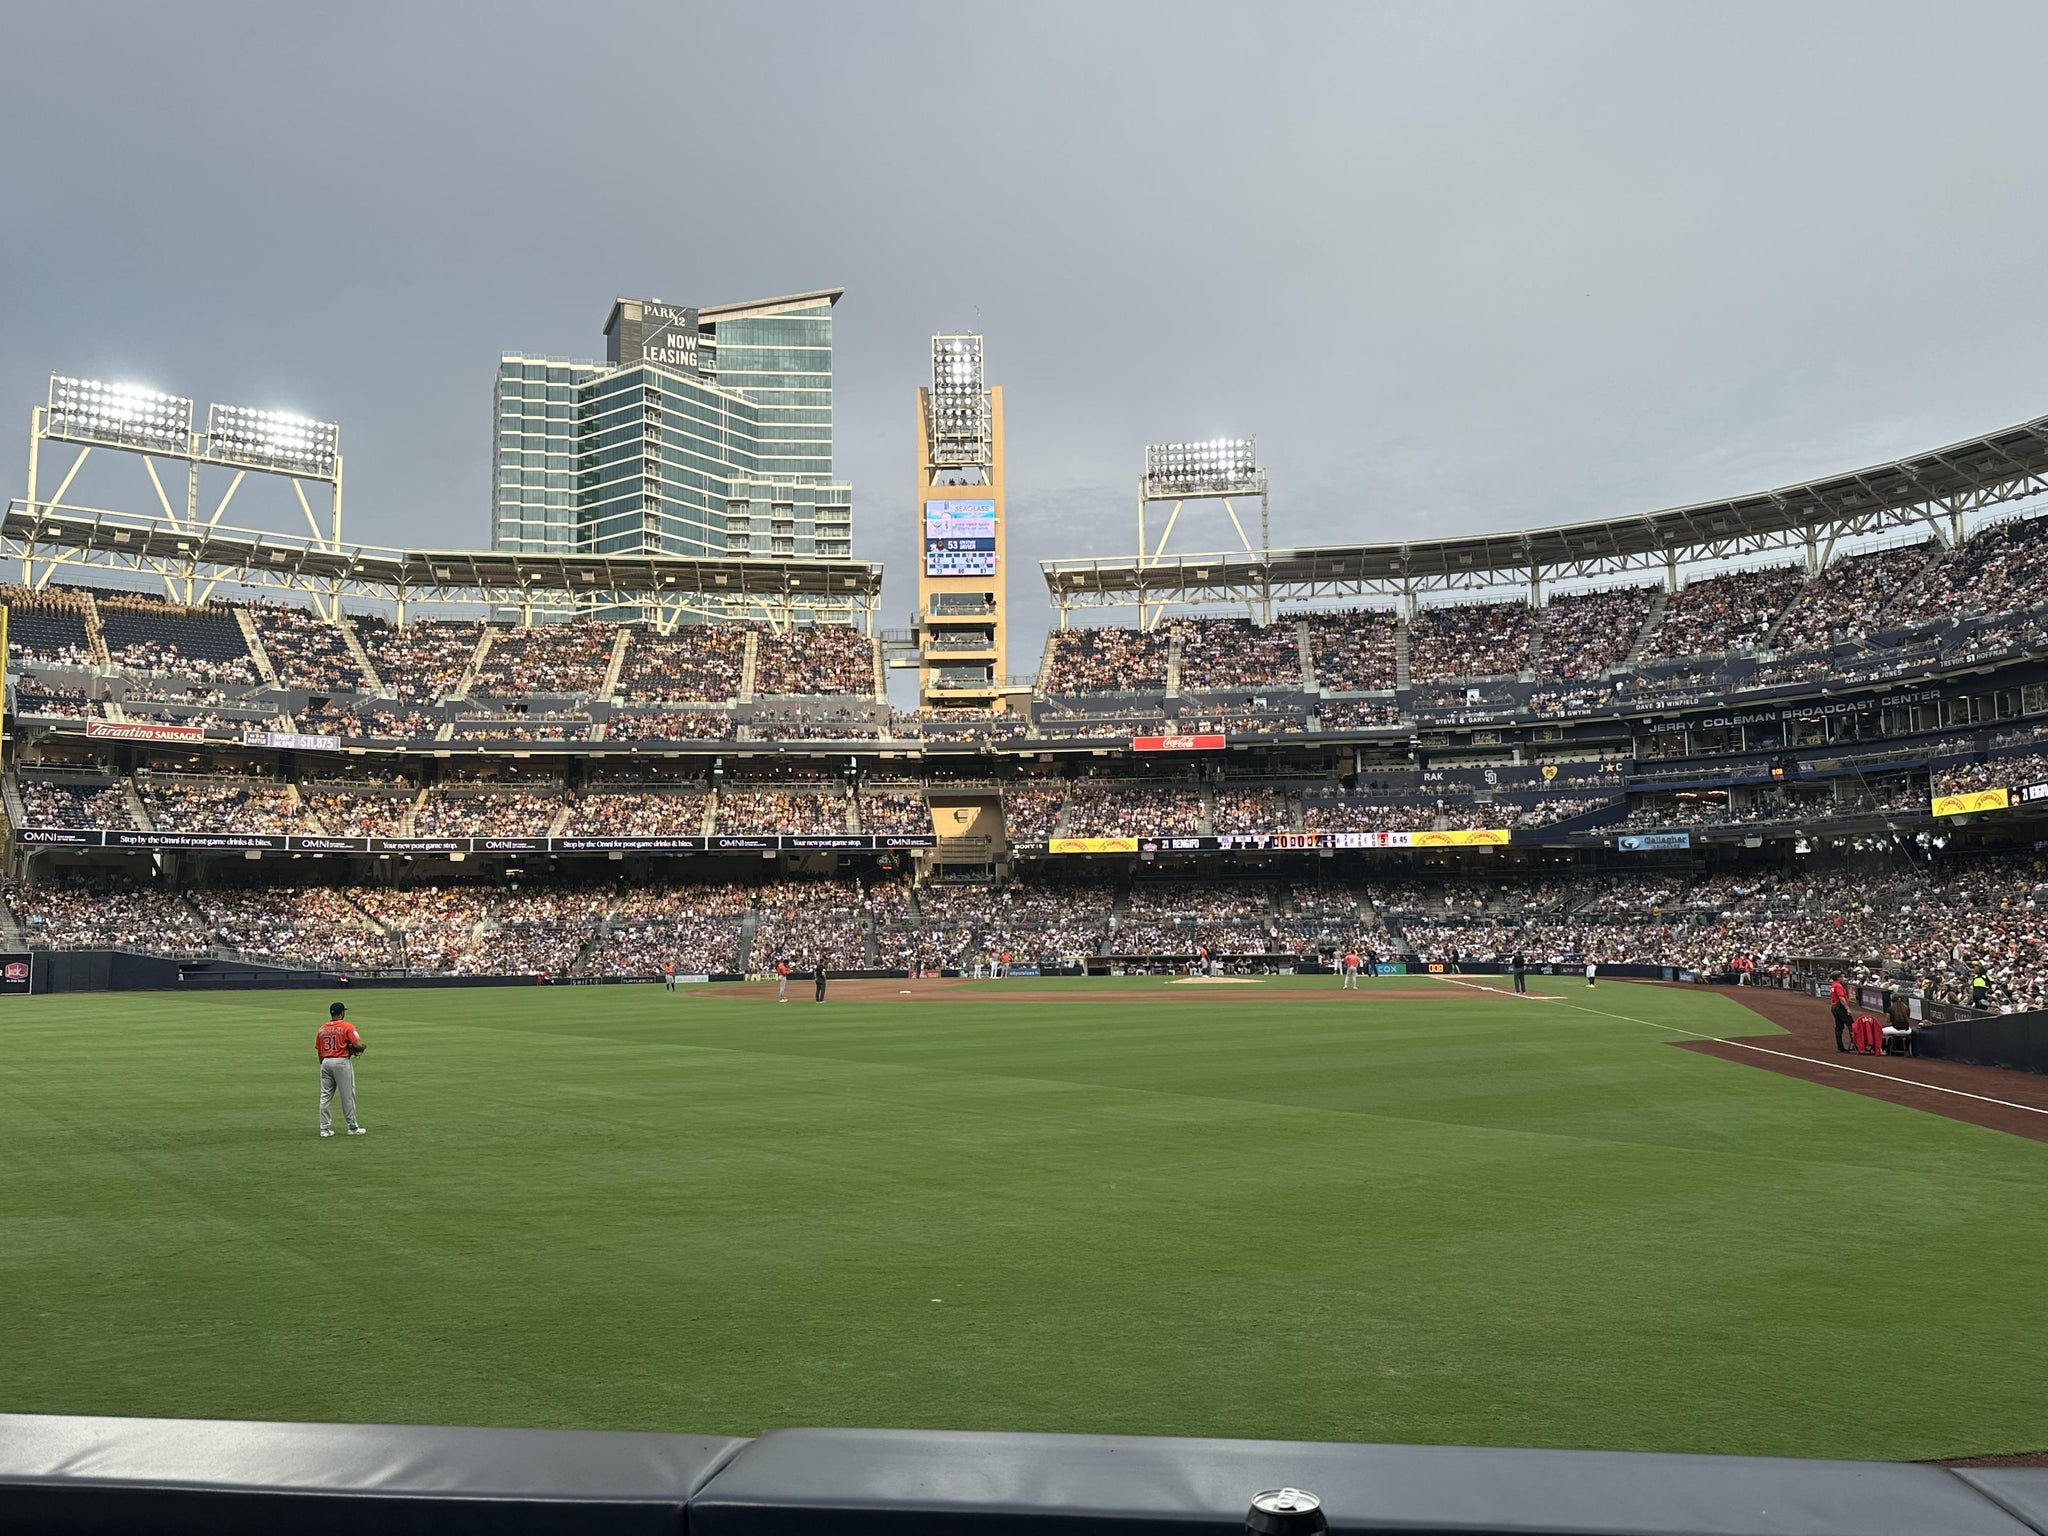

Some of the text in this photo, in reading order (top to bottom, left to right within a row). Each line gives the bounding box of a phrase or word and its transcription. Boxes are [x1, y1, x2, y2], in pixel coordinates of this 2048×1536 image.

[644, 305, 676, 320] PARK
[674, 316, 685, 327] 12
[667, 333, 697, 350] NOW
[643, 346, 697, 367] LEASING
[948, 541, 958, 549] 53
[1940, 648, 2008, 668] TREVOR 51 HOFFMAN
[1845, 670, 1902, 684] RANDY 35 JONES
[1667, 699, 1699, 707] WINFIELD
[1649, 690, 1941, 733] JERRY COLEMAN BROADCAST CENTER
[90, 724, 202, 741] Tarantino SAUSAGES
[301, 737, 333, 748] $11,875
[1163, 737, 1195, 748] Coca-Cola
[1424, 772, 1443, 781] RAK
[1484, 769, 1496, 785] SD
[24, 832, 56, 841] OMNI
[120, 836, 137, 844] Stop
[138, 836, 147, 844] by
[148, 836, 159, 844] the
[227, 838, 247, 846] drinks
[1281, 836, 1287, 847] 0
[1298, 836, 1304, 847] 0
[1381, 834, 1385, 843] 5
[1644, 836, 1687, 844] Gallagher
[302, 840, 329, 848] OMNI
[443, 842, 457, 850] stop.
[486, 841, 512, 849] OMNI
[563, 841, 579, 849] Stop
[580, 841, 589, 849] by
[887, 838, 910, 846] OMNI
[1162, 839, 1199, 849] 21 RENGIFO
[7, 965, 22, 975] Jack
[323, 1036, 336, 1051] 31
